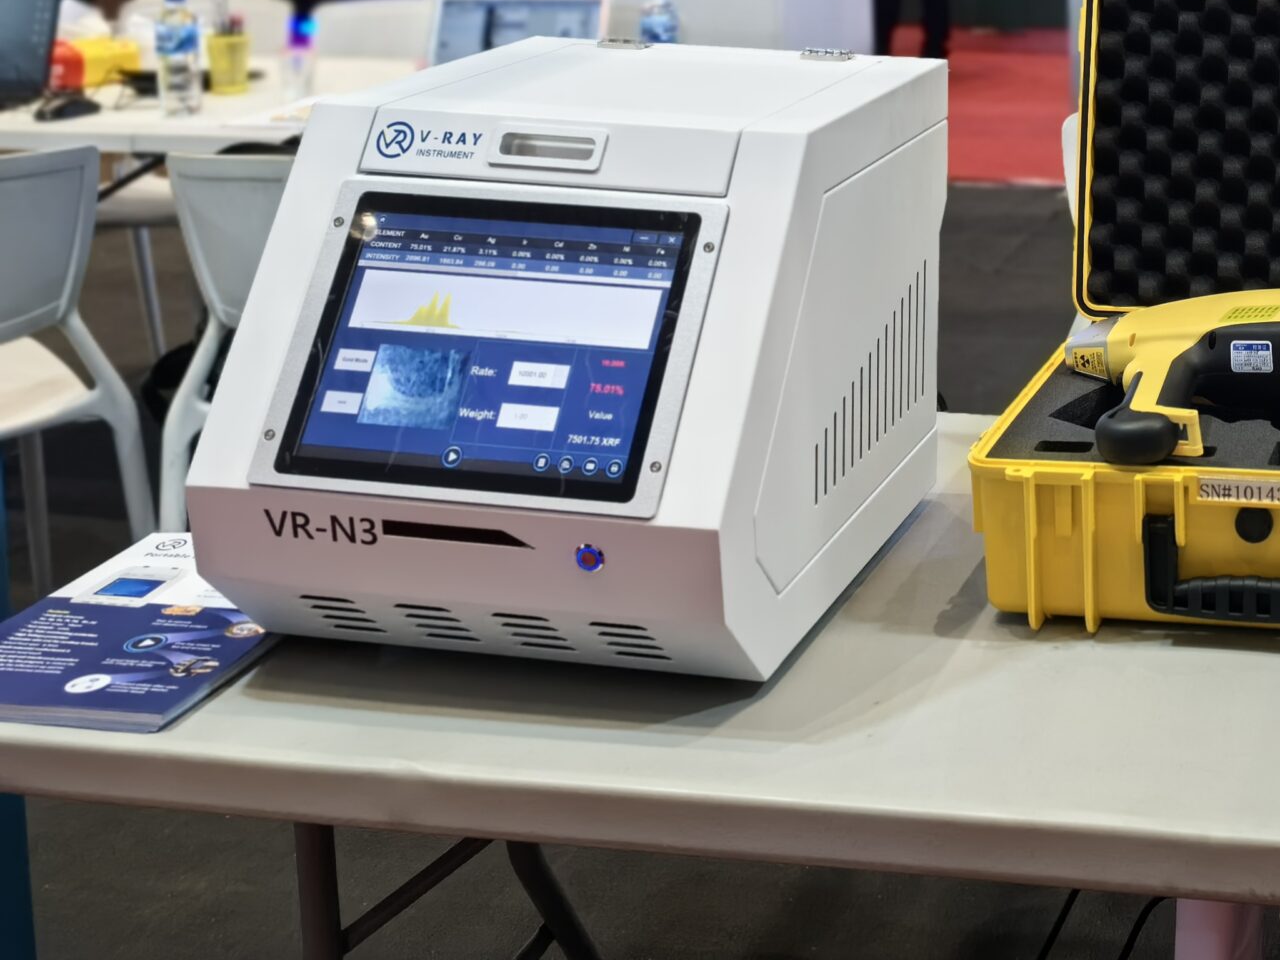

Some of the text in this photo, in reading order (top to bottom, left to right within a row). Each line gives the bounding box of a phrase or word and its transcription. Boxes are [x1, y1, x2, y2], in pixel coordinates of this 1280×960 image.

[416, 149, 475, 160] INSTRUMENT
[370, 240, 401, 249] CONTENT
[365, 253, 400, 261] INTENSITY
[471, 365, 498, 377] Rate:
[459, 407, 496, 420] Weight:
[588, 410, 614, 421] Value
[567, 434, 622, 447] 7501.75 XRF
[264, 508, 379, 546] VR-N3
